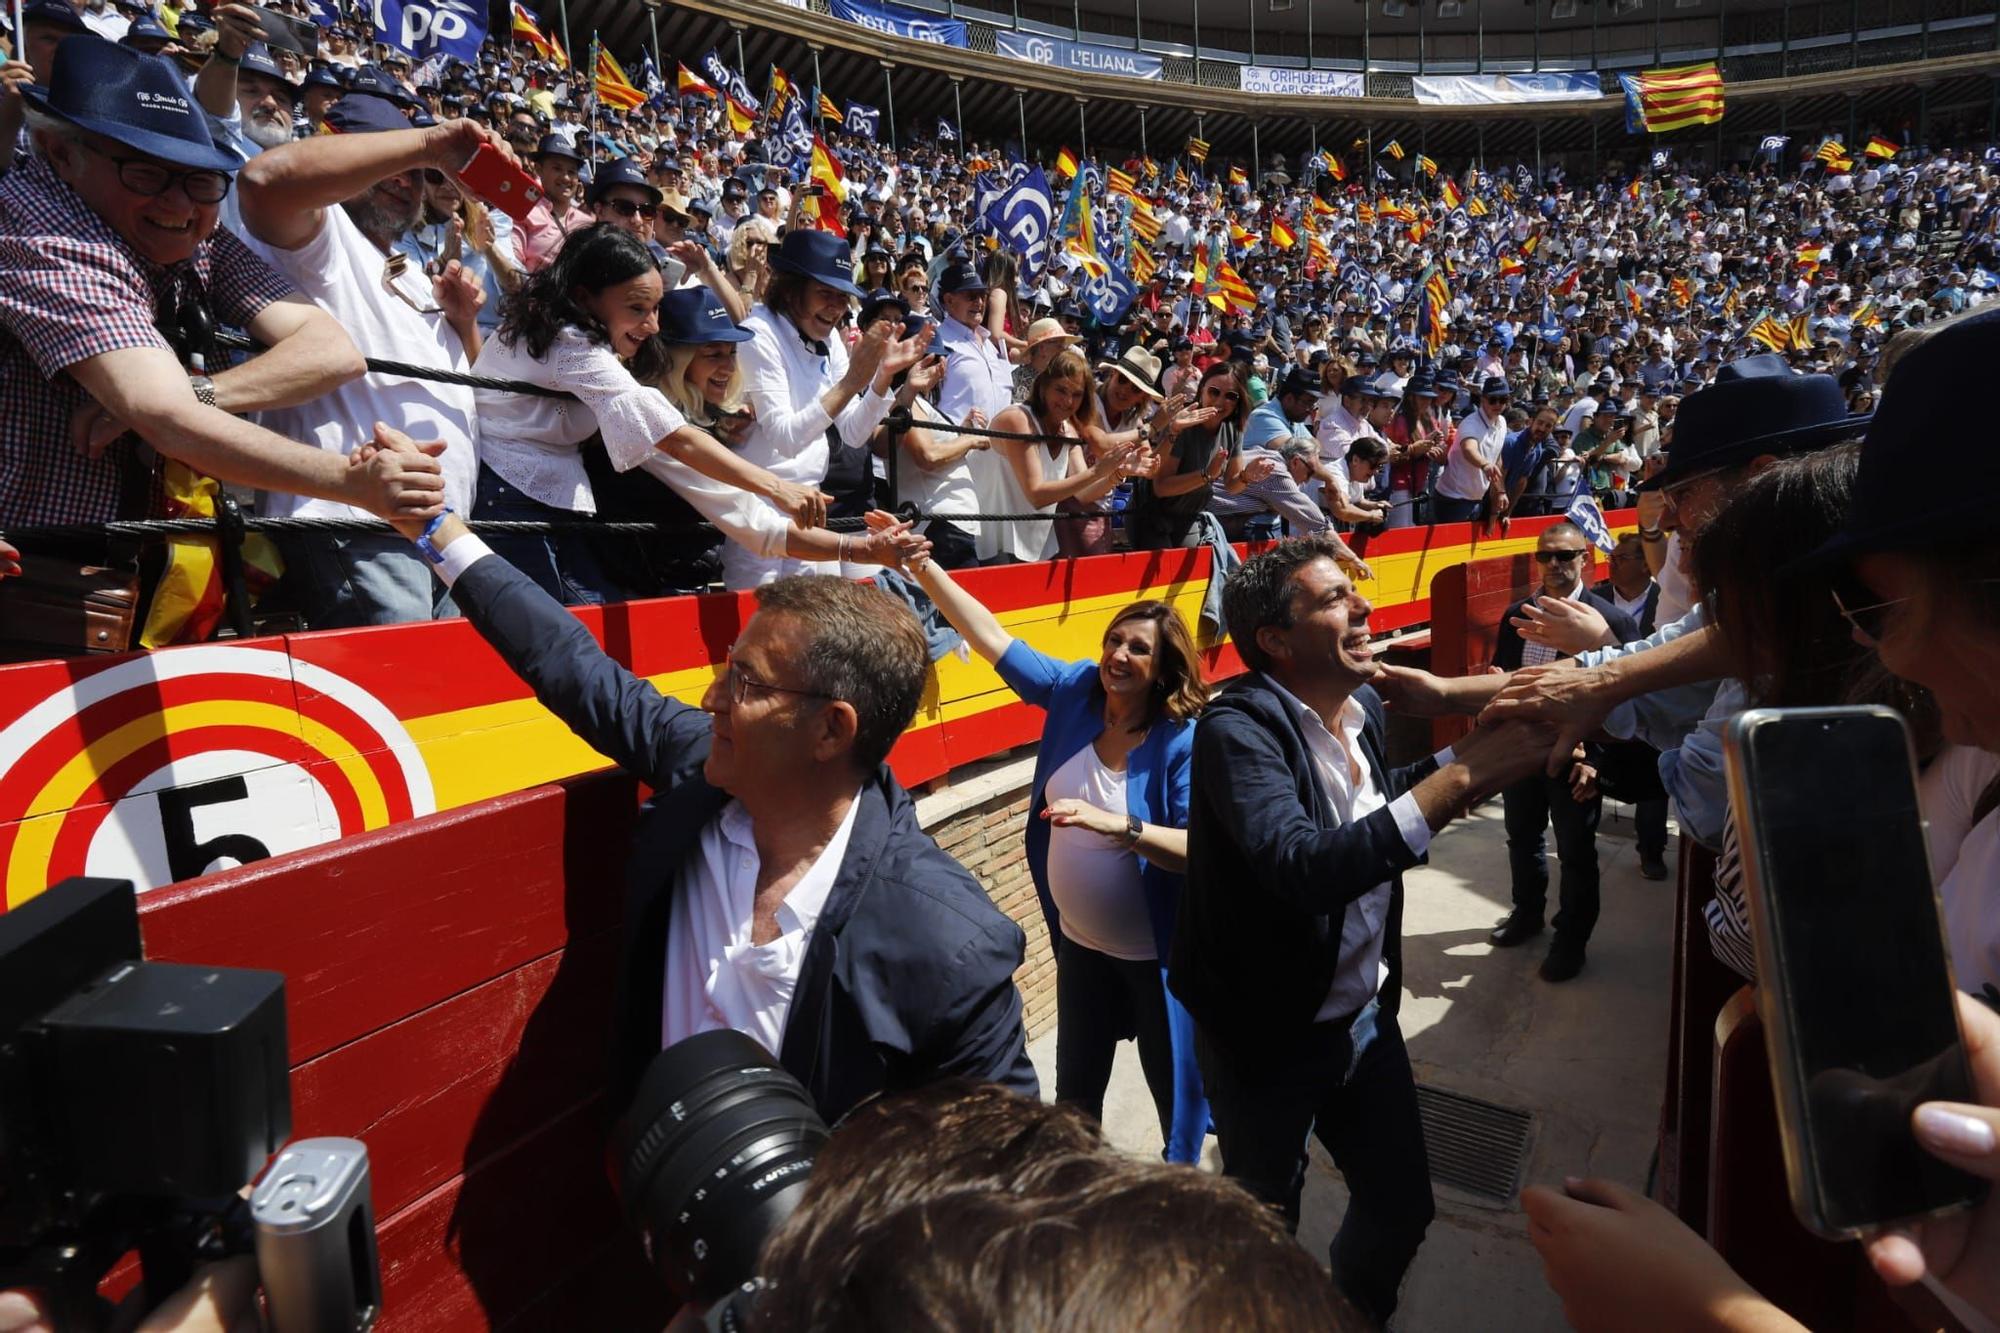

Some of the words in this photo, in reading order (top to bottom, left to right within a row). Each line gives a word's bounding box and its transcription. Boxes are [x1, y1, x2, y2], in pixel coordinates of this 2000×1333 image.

[850, 10, 898, 36] VOTA
[1071, 48, 1137, 72] L'ELIANA
[1245, 81, 1270, 92] CON
[1273, 83, 1316, 95] CARLOS
[1269, 69, 1335, 85] ORIHUELA
[157, 775, 271, 884] 5
